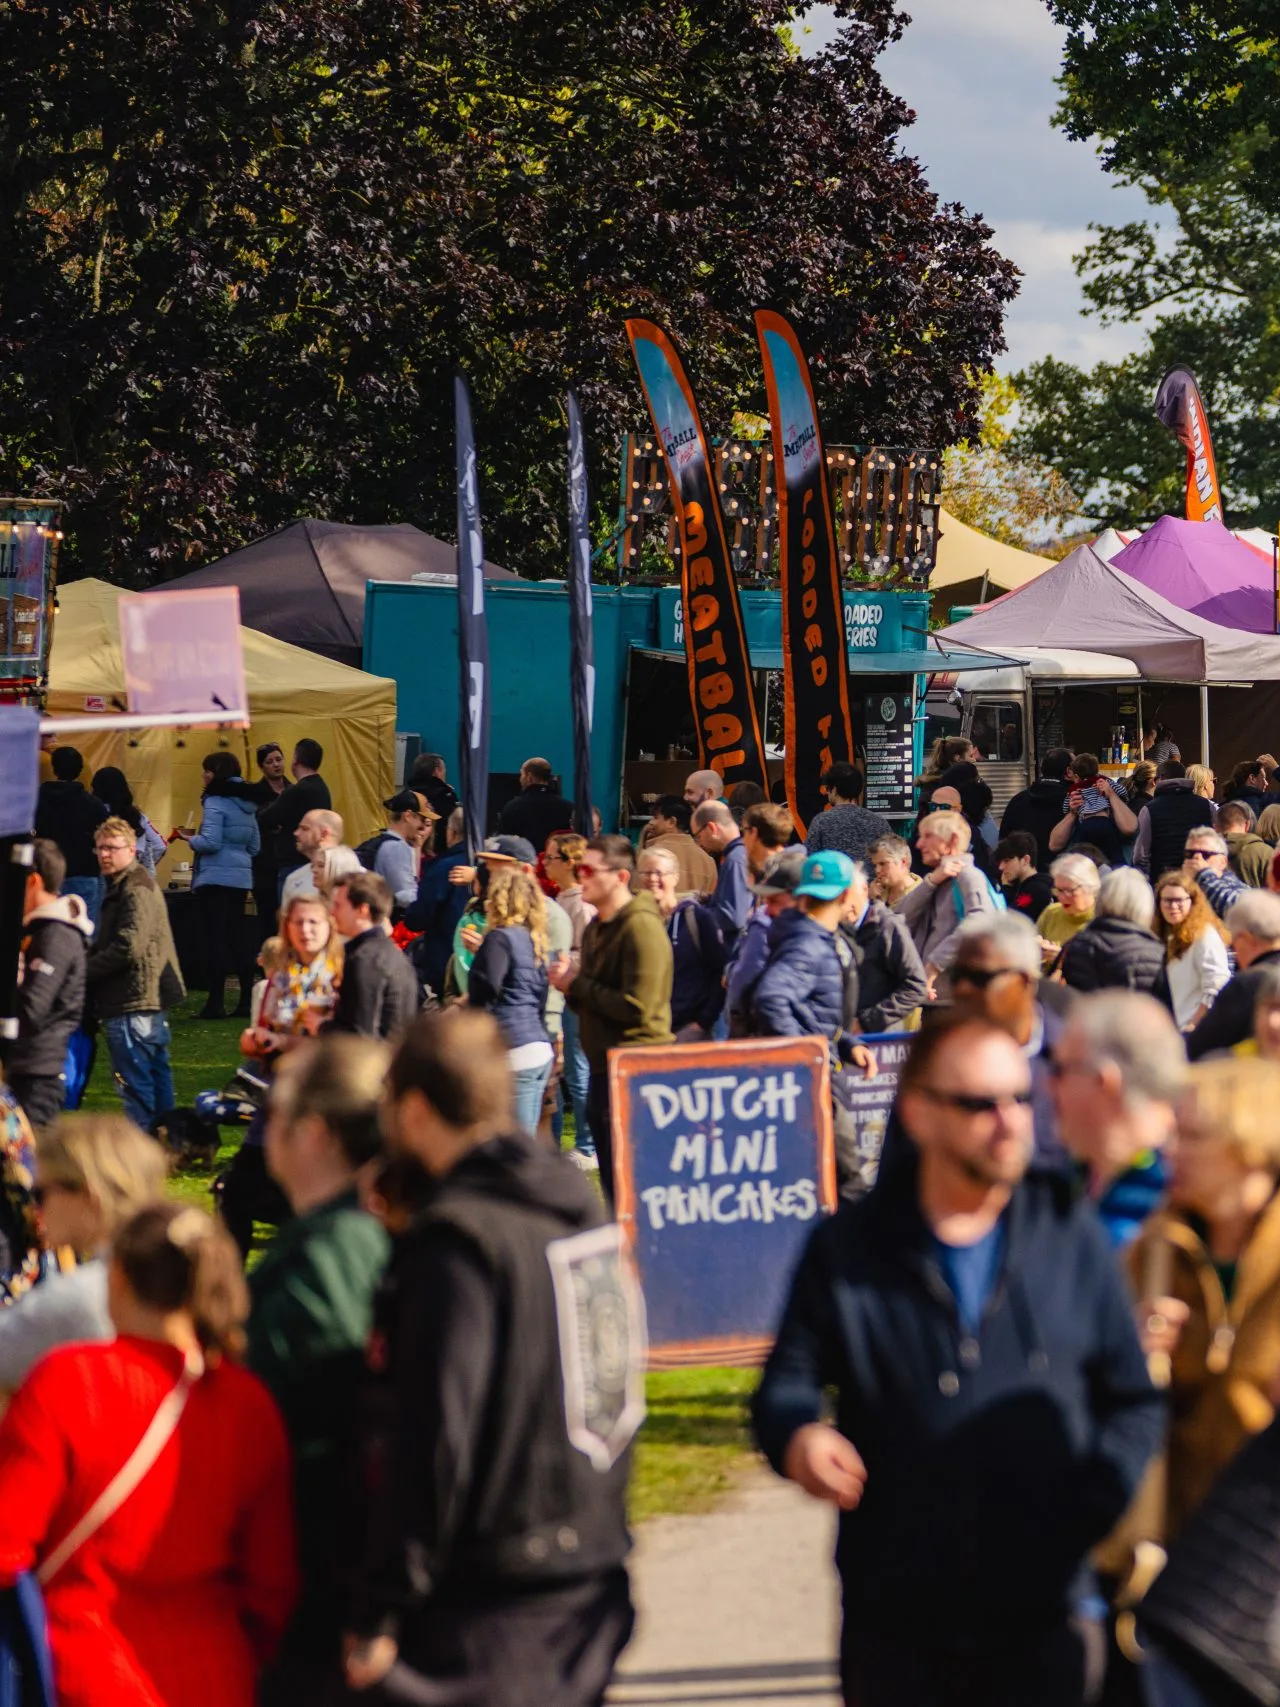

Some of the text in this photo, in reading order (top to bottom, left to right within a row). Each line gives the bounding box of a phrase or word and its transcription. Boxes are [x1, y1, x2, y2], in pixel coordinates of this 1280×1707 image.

[844, 604, 883, 625] OADED
[684, 501, 746, 800] MEATBAL
[639, 1071, 802, 1129] DUTCH
[640, 1178, 817, 1230] PANCAKES
